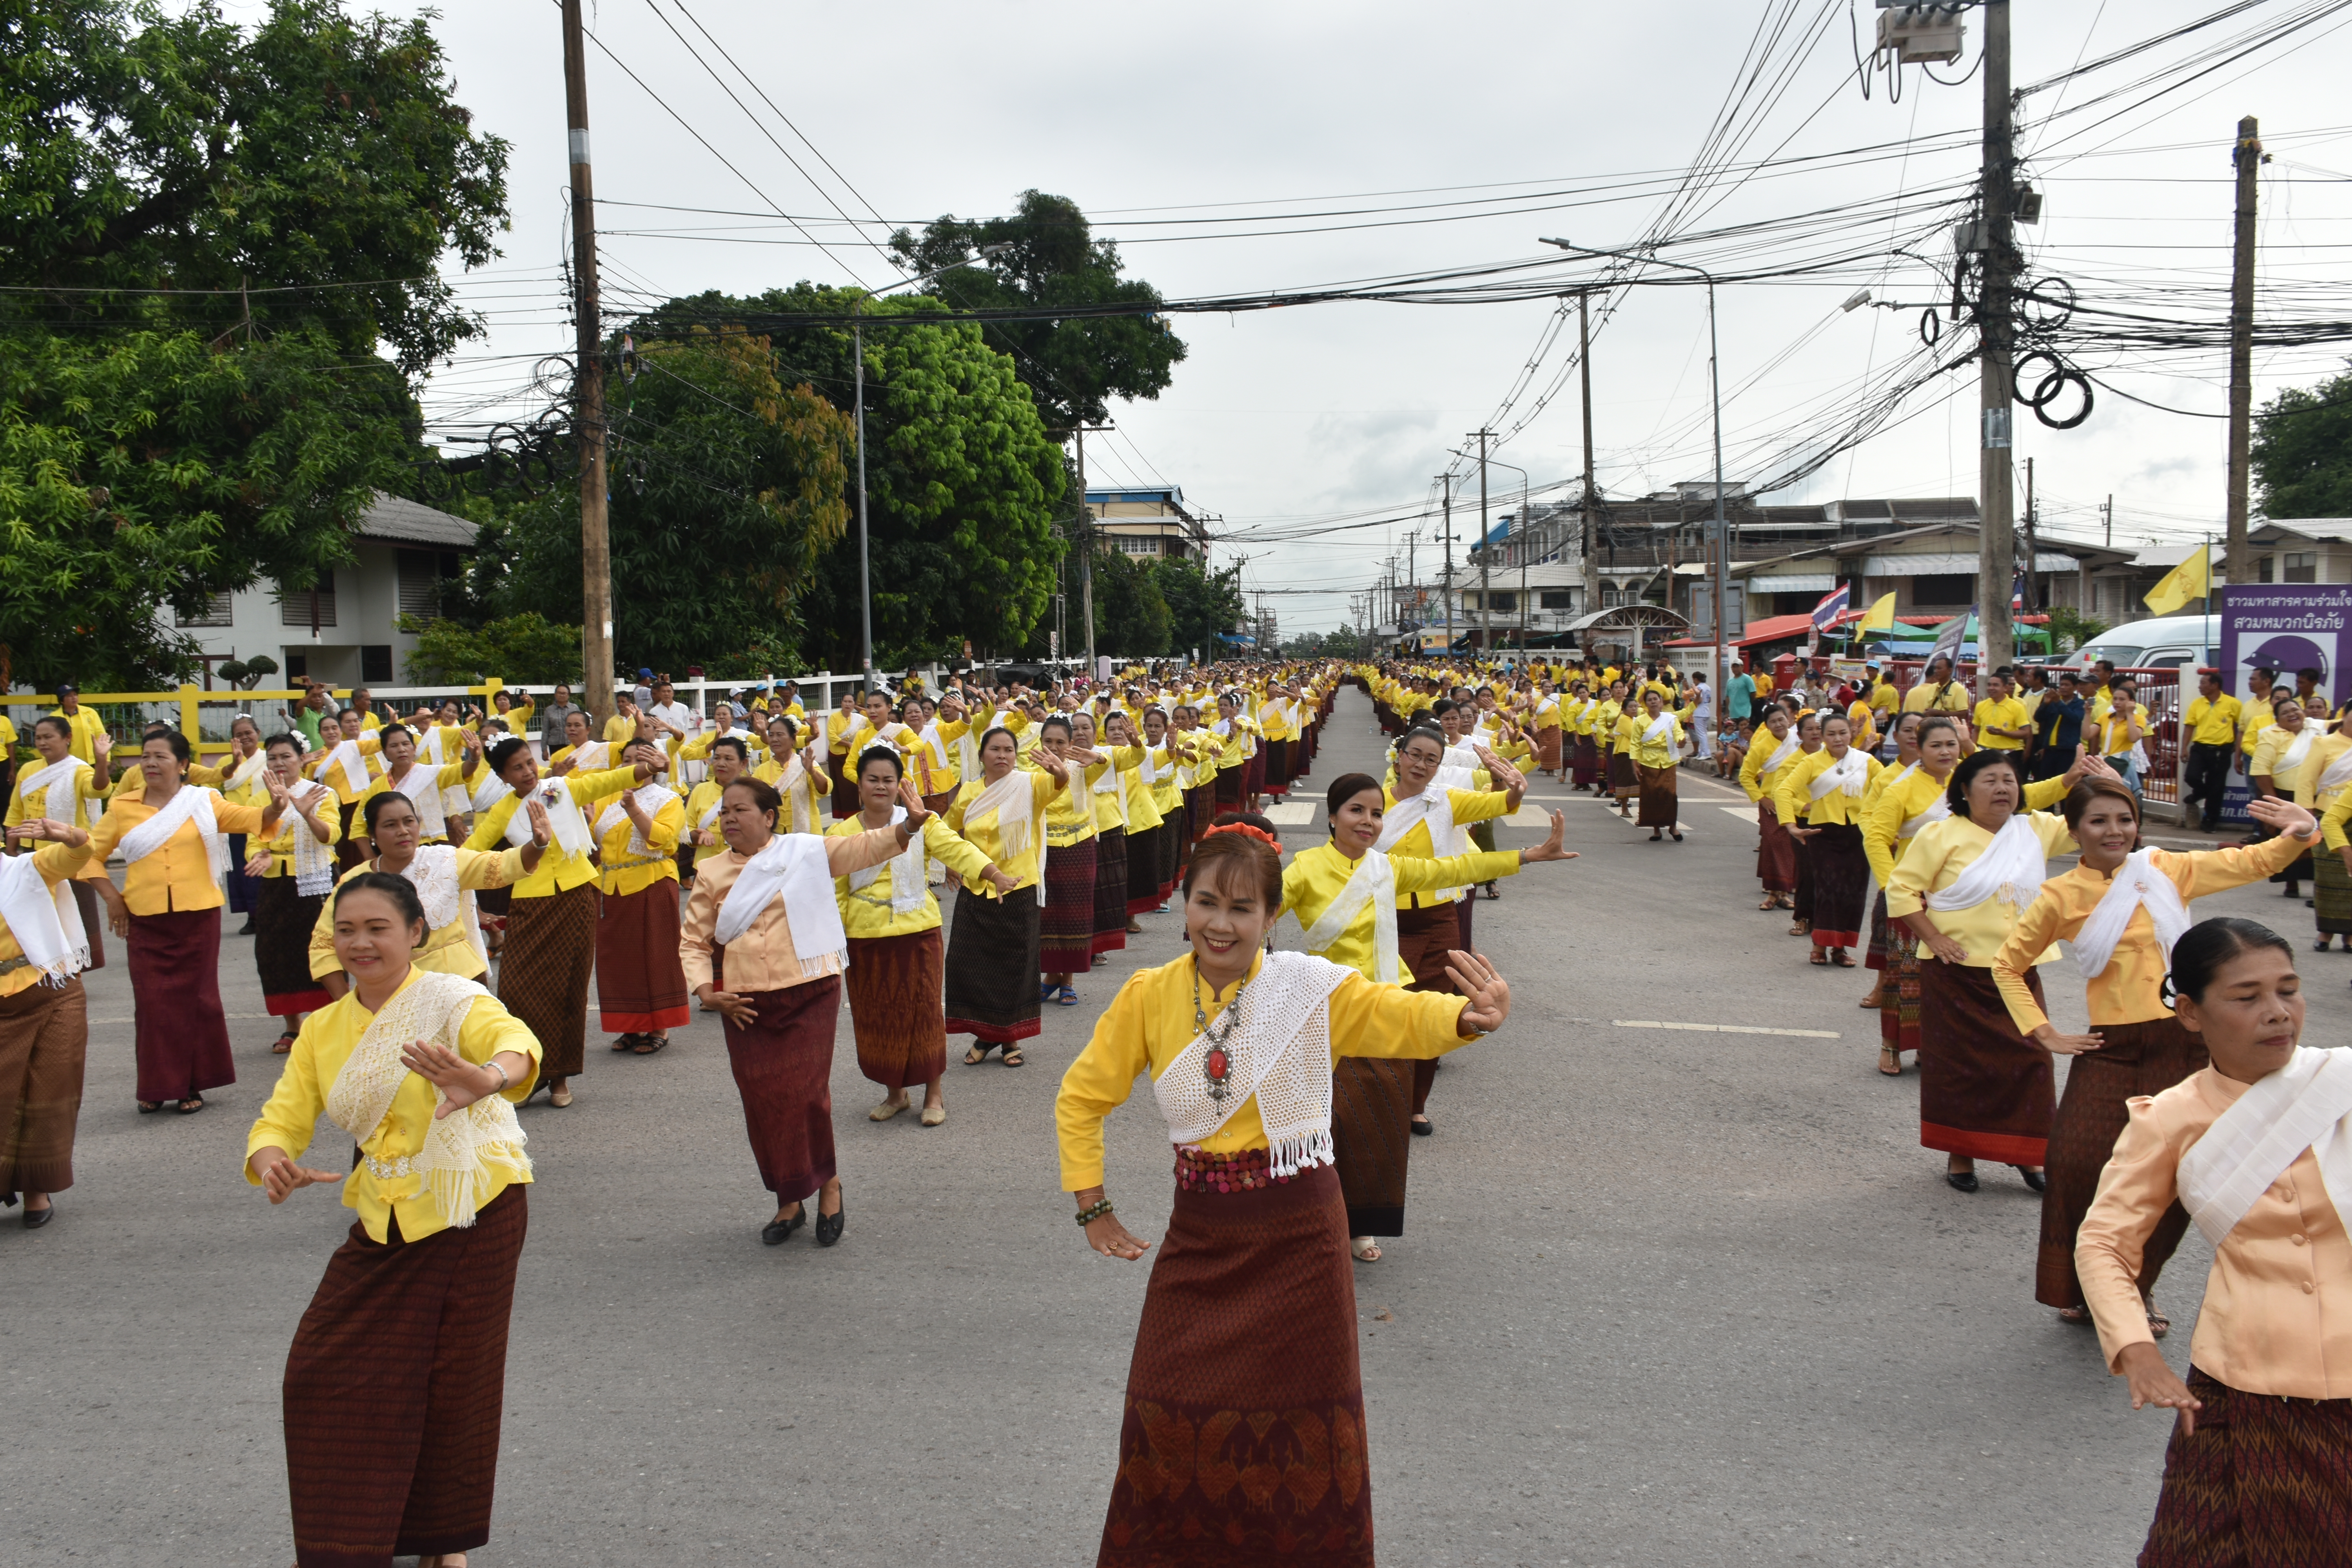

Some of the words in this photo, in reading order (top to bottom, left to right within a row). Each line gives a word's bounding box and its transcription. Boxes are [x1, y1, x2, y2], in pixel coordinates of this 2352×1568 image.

[2227, 590, 2352, 606] ชาวมหาสารคามร่วมใจ
[2234, 612, 2344, 628] สวมหมวกนิรภัย
